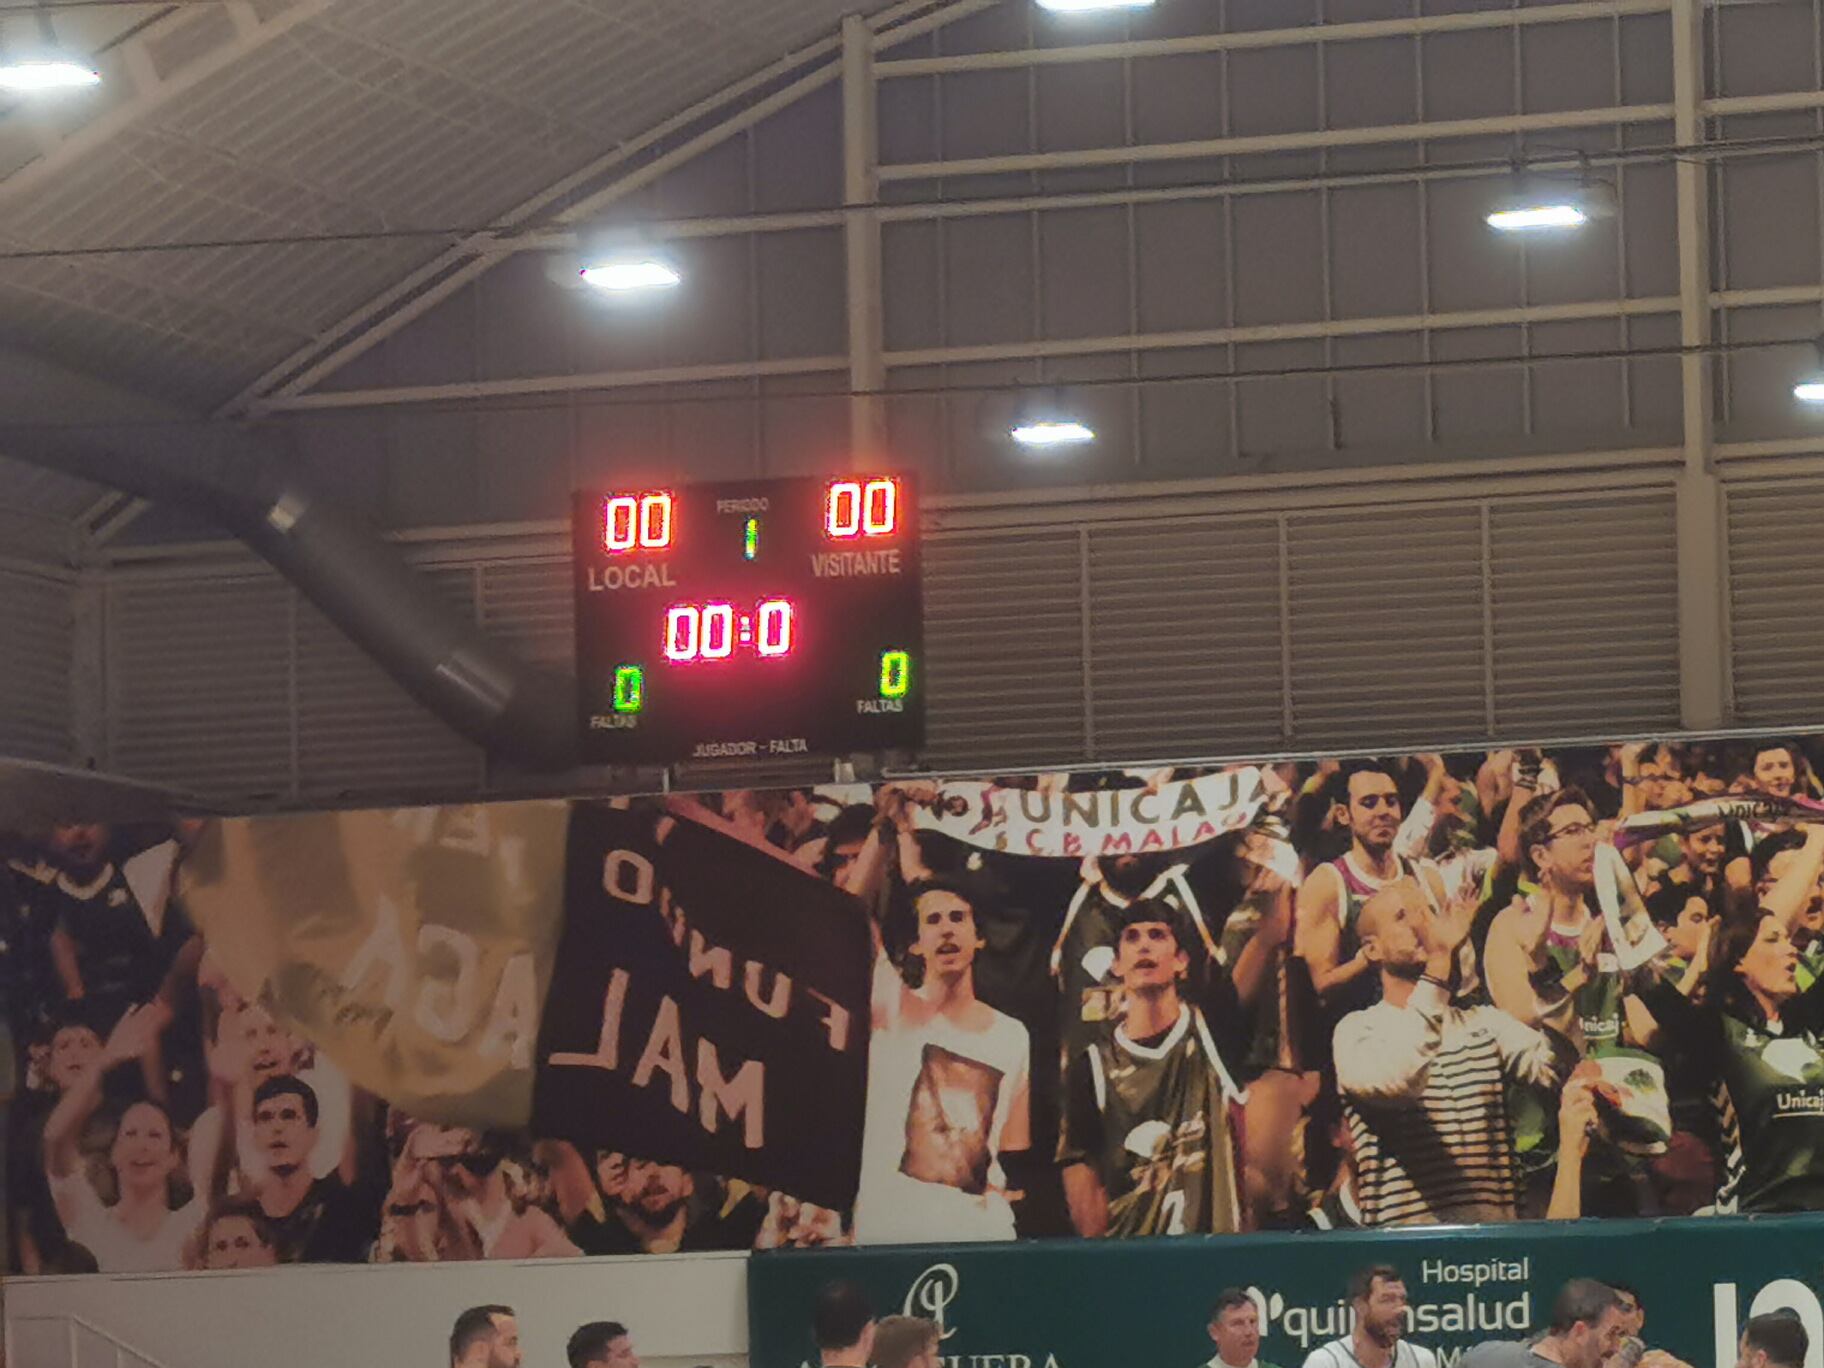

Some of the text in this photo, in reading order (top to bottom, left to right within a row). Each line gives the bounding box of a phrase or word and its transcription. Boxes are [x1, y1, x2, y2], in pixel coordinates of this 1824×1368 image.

[605, 495, 672, 551] 00
[828, 481, 896, 537] 00
[588, 563, 676, 591] LOCAL
[813, 550, 901, 577] VISITANTE
[613, 665, 643, 712] 0
[879, 650, 909, 698] 0
[856, 700, 903, 714] FALTAS
[590, 715, 638, 730] FALTAS
[693, 740, 757, 758] JUGADOR
[769, 738, 808, 754] FALTA
[1422, 1257, 1529, 1287] Hospital
